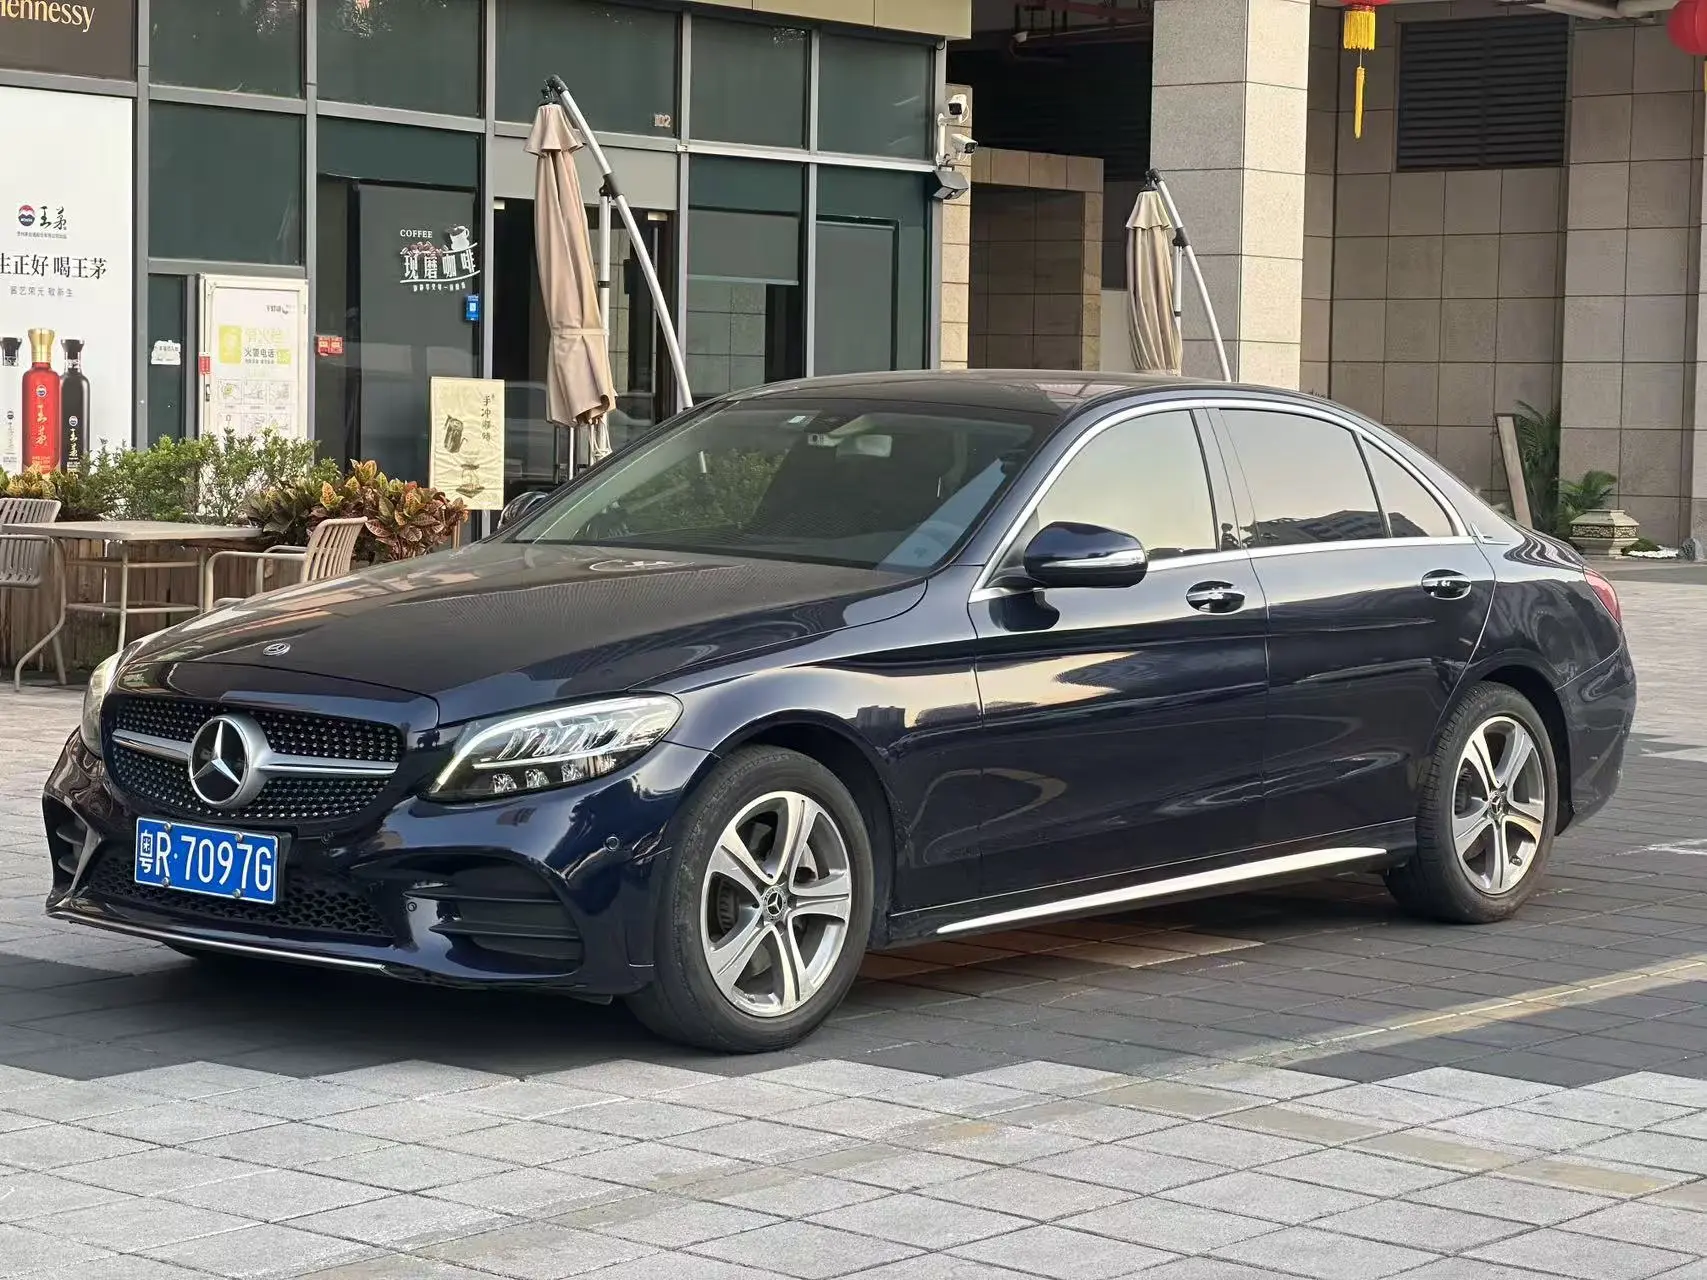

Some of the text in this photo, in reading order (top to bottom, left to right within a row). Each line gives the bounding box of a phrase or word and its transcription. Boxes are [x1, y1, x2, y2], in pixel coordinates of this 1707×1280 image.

[399, 229, 433, 239] COFFEE
[53, 256, 107, 280] 喝王茅
[403, 248, 476, 280] 现磨咖啡
